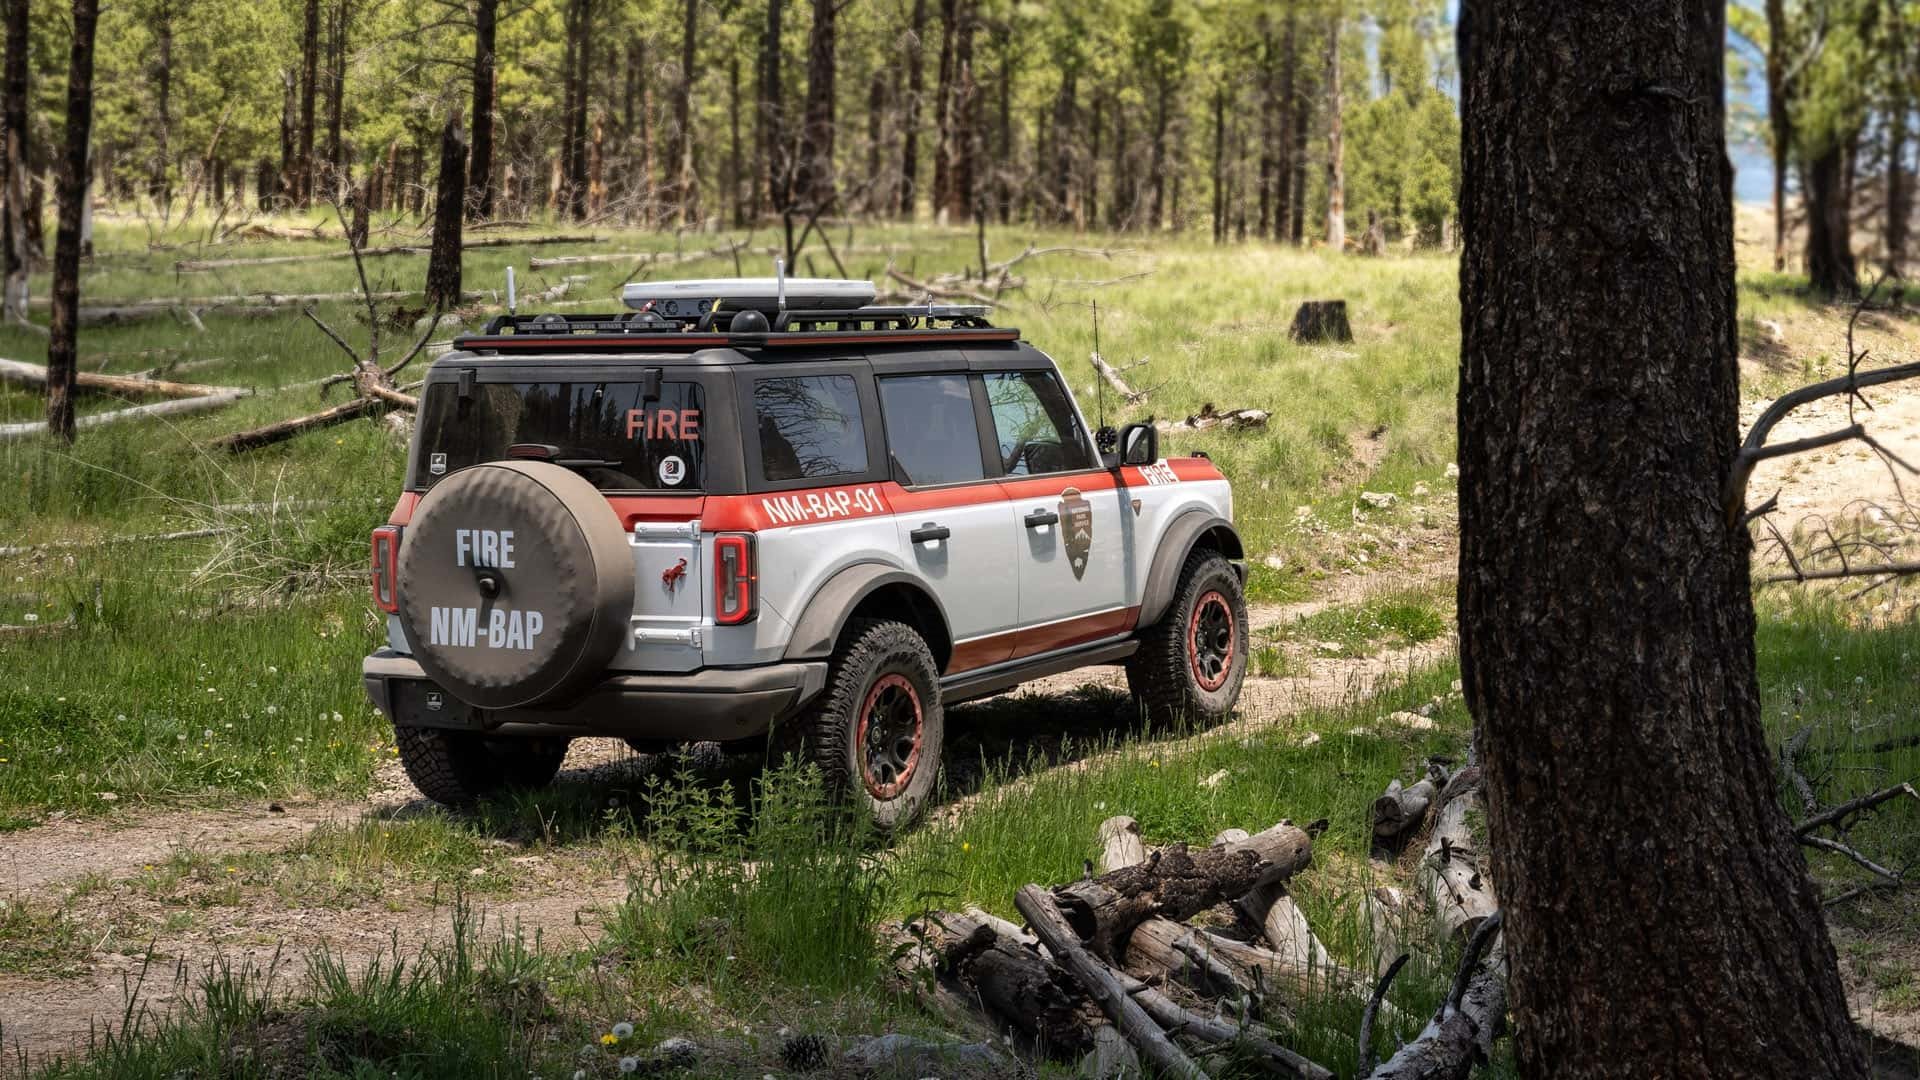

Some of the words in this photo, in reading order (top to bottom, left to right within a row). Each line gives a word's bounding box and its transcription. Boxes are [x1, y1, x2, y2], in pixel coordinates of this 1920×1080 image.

[626, 409, 699, 440] FIRE
[1137, 458, 1180, 486] FIRE
[762, 487, 884, 524] NM-BAP-01
[456, 528, 515, 568] FIRE
[430, 606, 543, 650] NM-BAP
